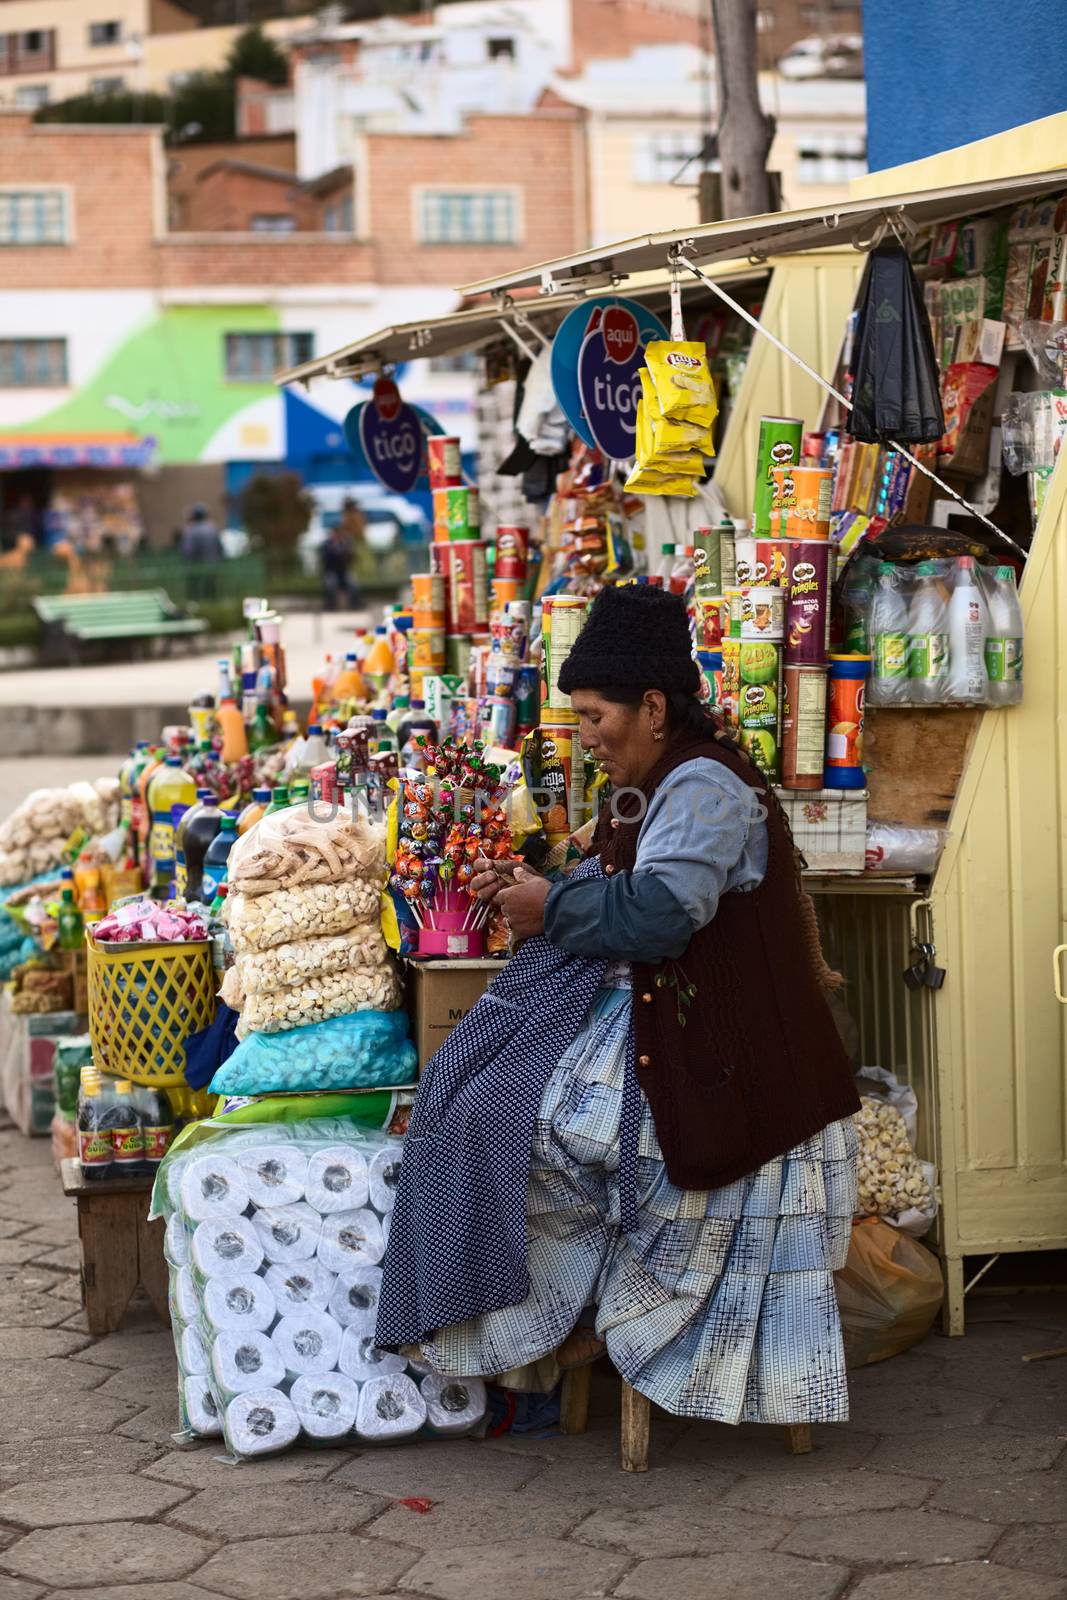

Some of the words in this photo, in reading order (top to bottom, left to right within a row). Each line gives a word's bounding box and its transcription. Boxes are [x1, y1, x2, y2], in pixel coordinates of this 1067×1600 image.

[606, 324, 634, 348] aquí
[374, 430, 416, 461] tigo
[790, 580, 819, 599] Pringles
[803, 603, 820, 612] BBQ
[743, 702, 769, 720] Pringles
[541, 772, 565, 788] rtilla
